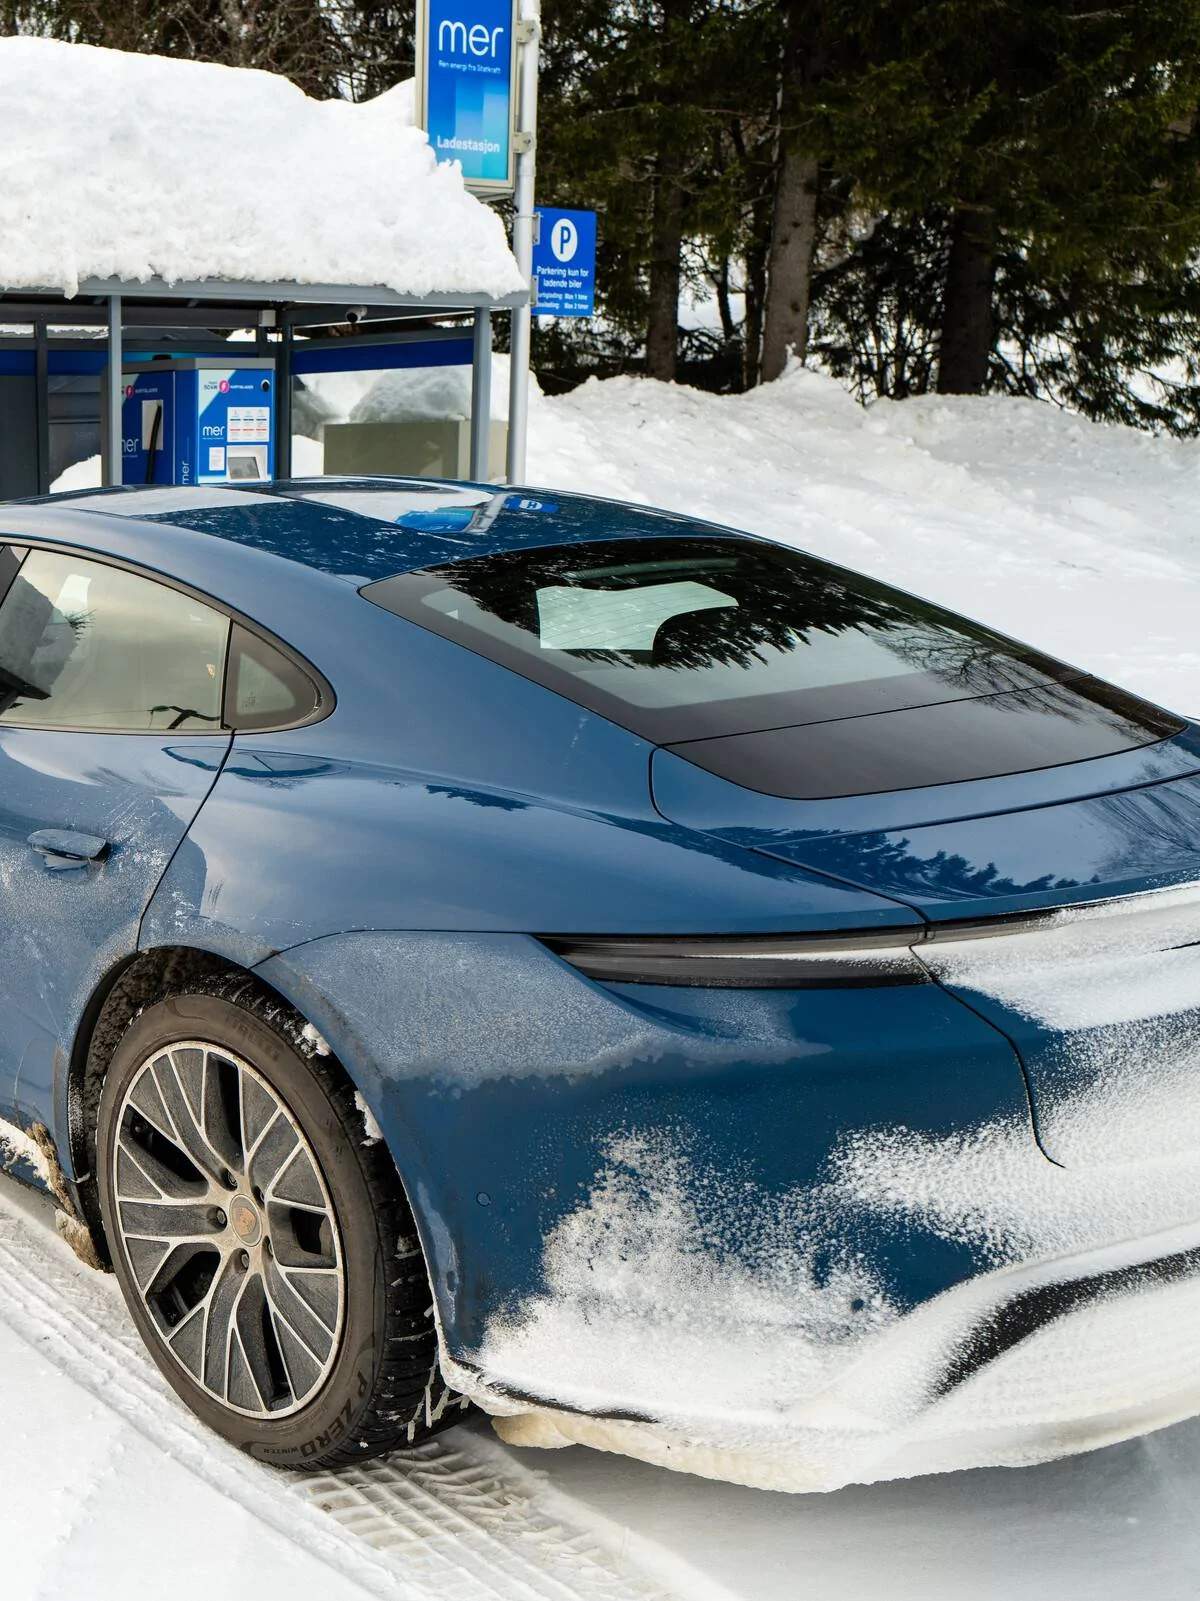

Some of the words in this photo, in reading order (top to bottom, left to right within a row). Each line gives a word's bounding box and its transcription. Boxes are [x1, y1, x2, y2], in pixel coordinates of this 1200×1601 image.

[439, 20, 504, 57] mer
[437, 135, 500, 154] Ladestasjon
[560, 226, 571, 254] P
[537, 266, 566, 277] Parkering
[568, 267, 580, 276] kun
[580, 268, 590, 277] for
[543, 279, 567, 288] ladende
[569, 280, 582, 288] biler
[203, 426, 225, 436] mer
[357, 1371, 368, 1397] P
[300, 1398, 355, 1457] ZERO
